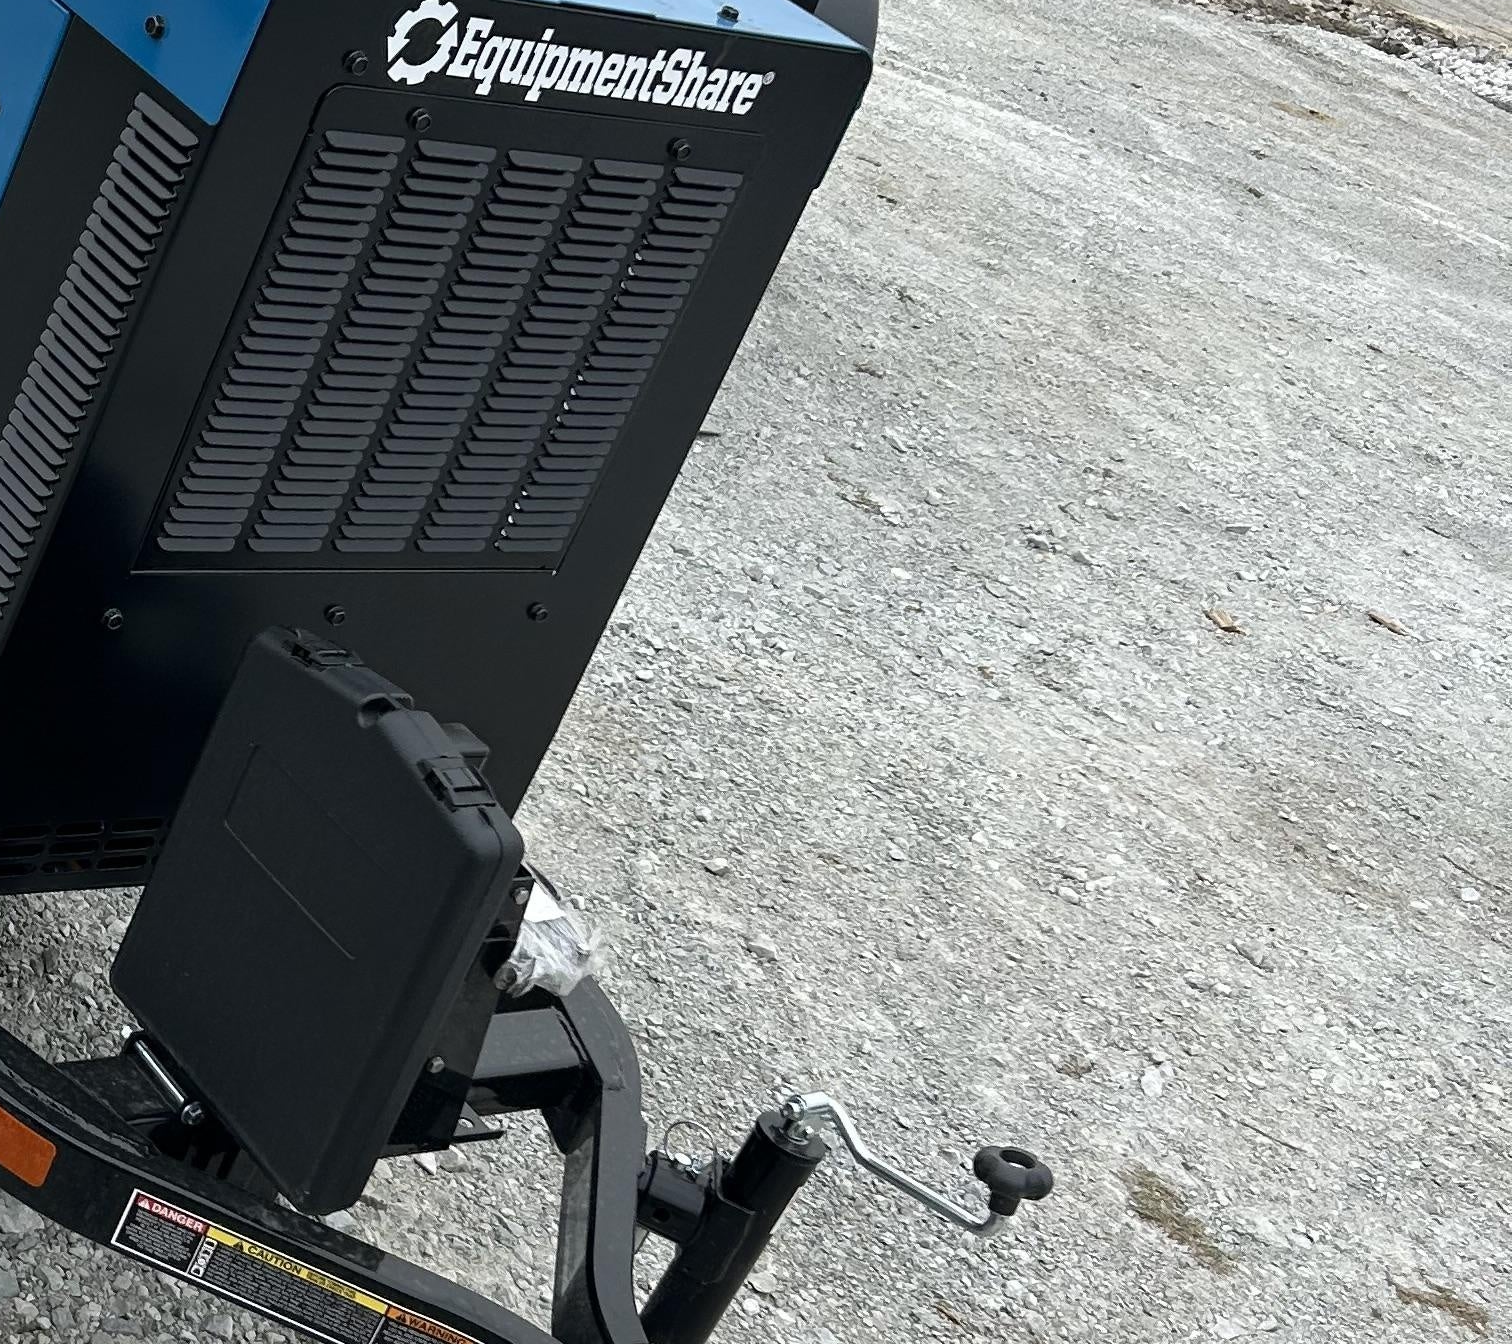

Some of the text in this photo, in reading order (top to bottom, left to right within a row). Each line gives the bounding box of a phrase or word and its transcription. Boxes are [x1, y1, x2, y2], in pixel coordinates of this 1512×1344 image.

[445, 16, 765, 116] EquipmentShare
[152, 1204, 205, 1235] DANGER
[247, 1244, 303, 1275] CAUTION
